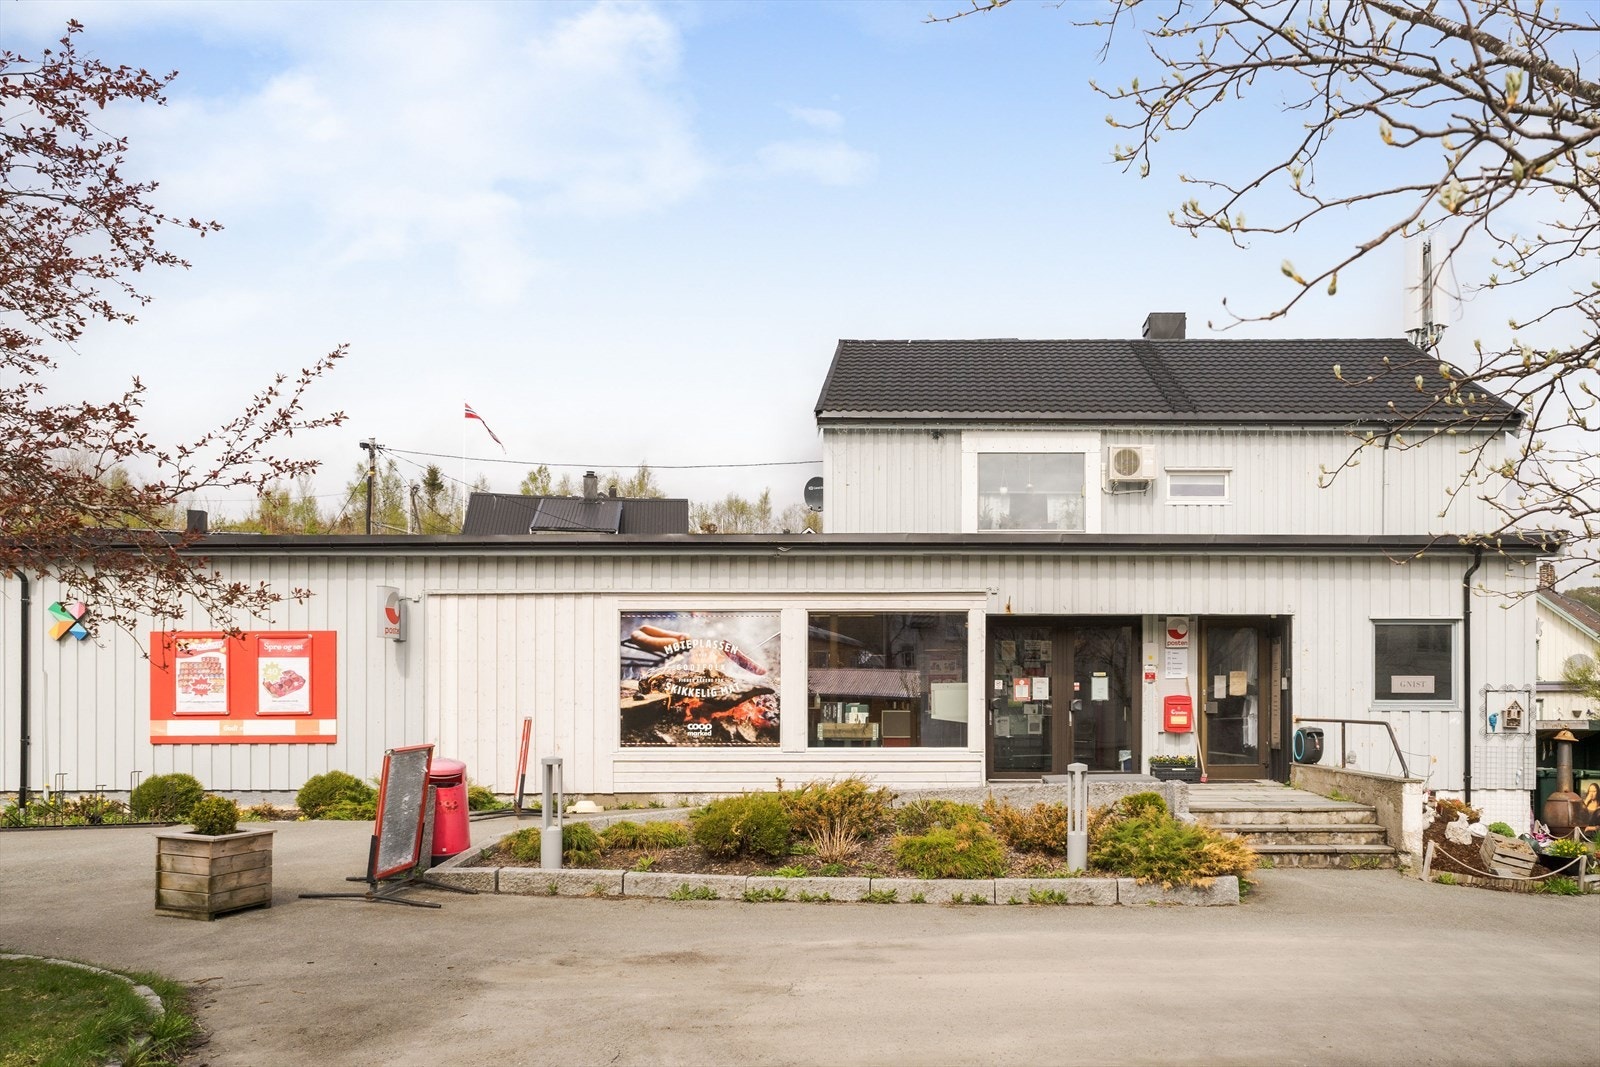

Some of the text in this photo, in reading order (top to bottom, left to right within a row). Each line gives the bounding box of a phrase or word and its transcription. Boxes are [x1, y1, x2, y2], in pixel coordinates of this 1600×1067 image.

[664, 639, 738, 655] MØTEPLASSEN
[665, 682, 740, 698] SKIKKELIG MAT
[687, 723, 713, 731] coop
